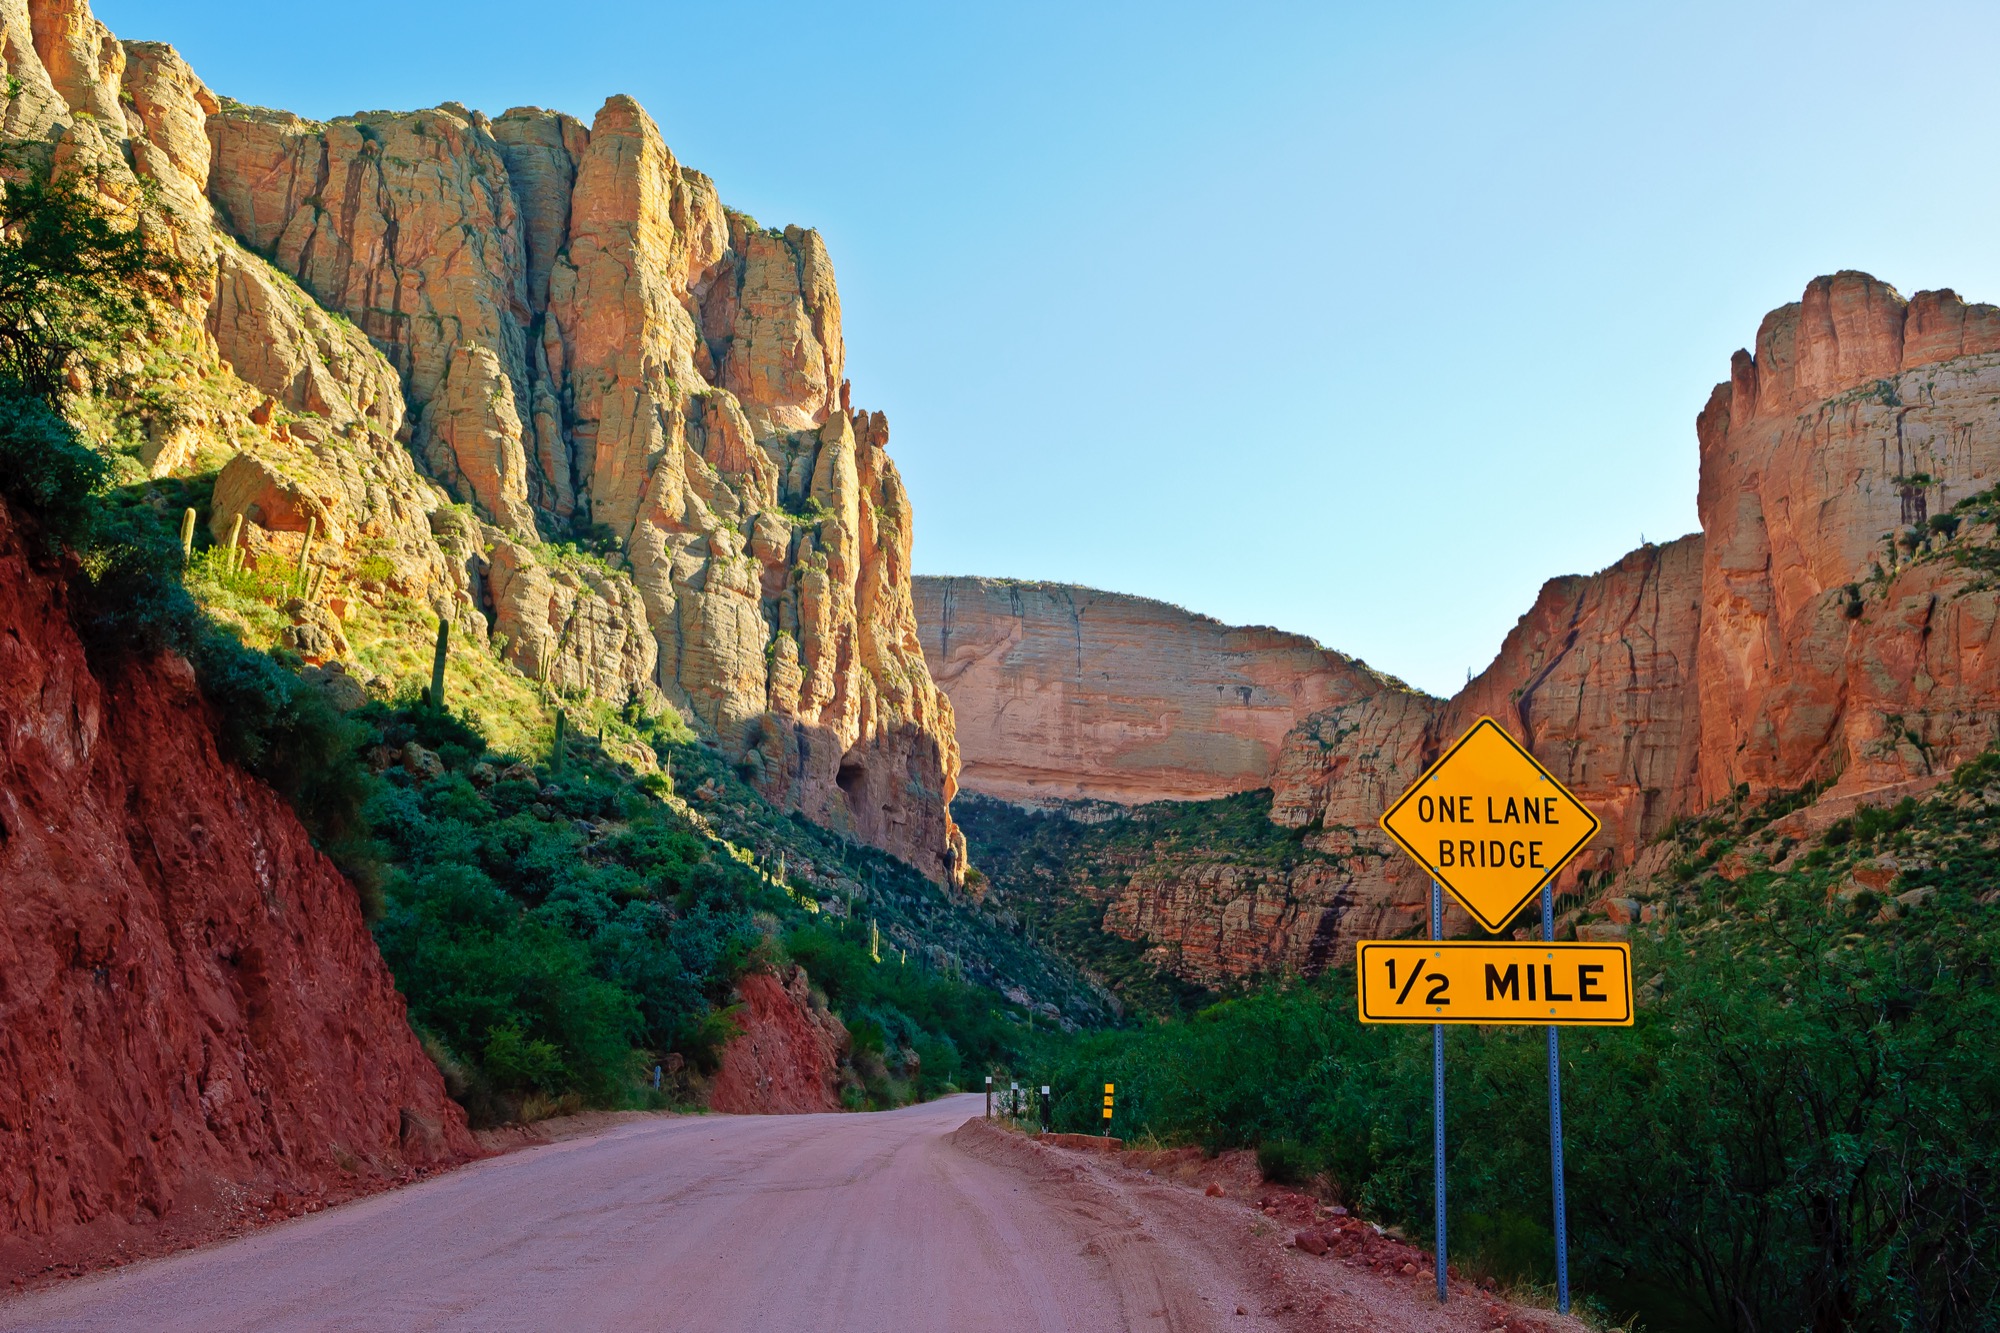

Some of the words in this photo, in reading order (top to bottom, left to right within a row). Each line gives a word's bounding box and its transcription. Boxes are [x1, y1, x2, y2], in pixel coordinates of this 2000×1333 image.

[1418, 795, 1474, 823] ONE
[1488, 796, 1559, 825] LANE
[1439, 840, 1545, 869] BRIDGE
[1384, 958, 1451, 1005] 1/2
[1484, 963, 1607, 1002] MILE
